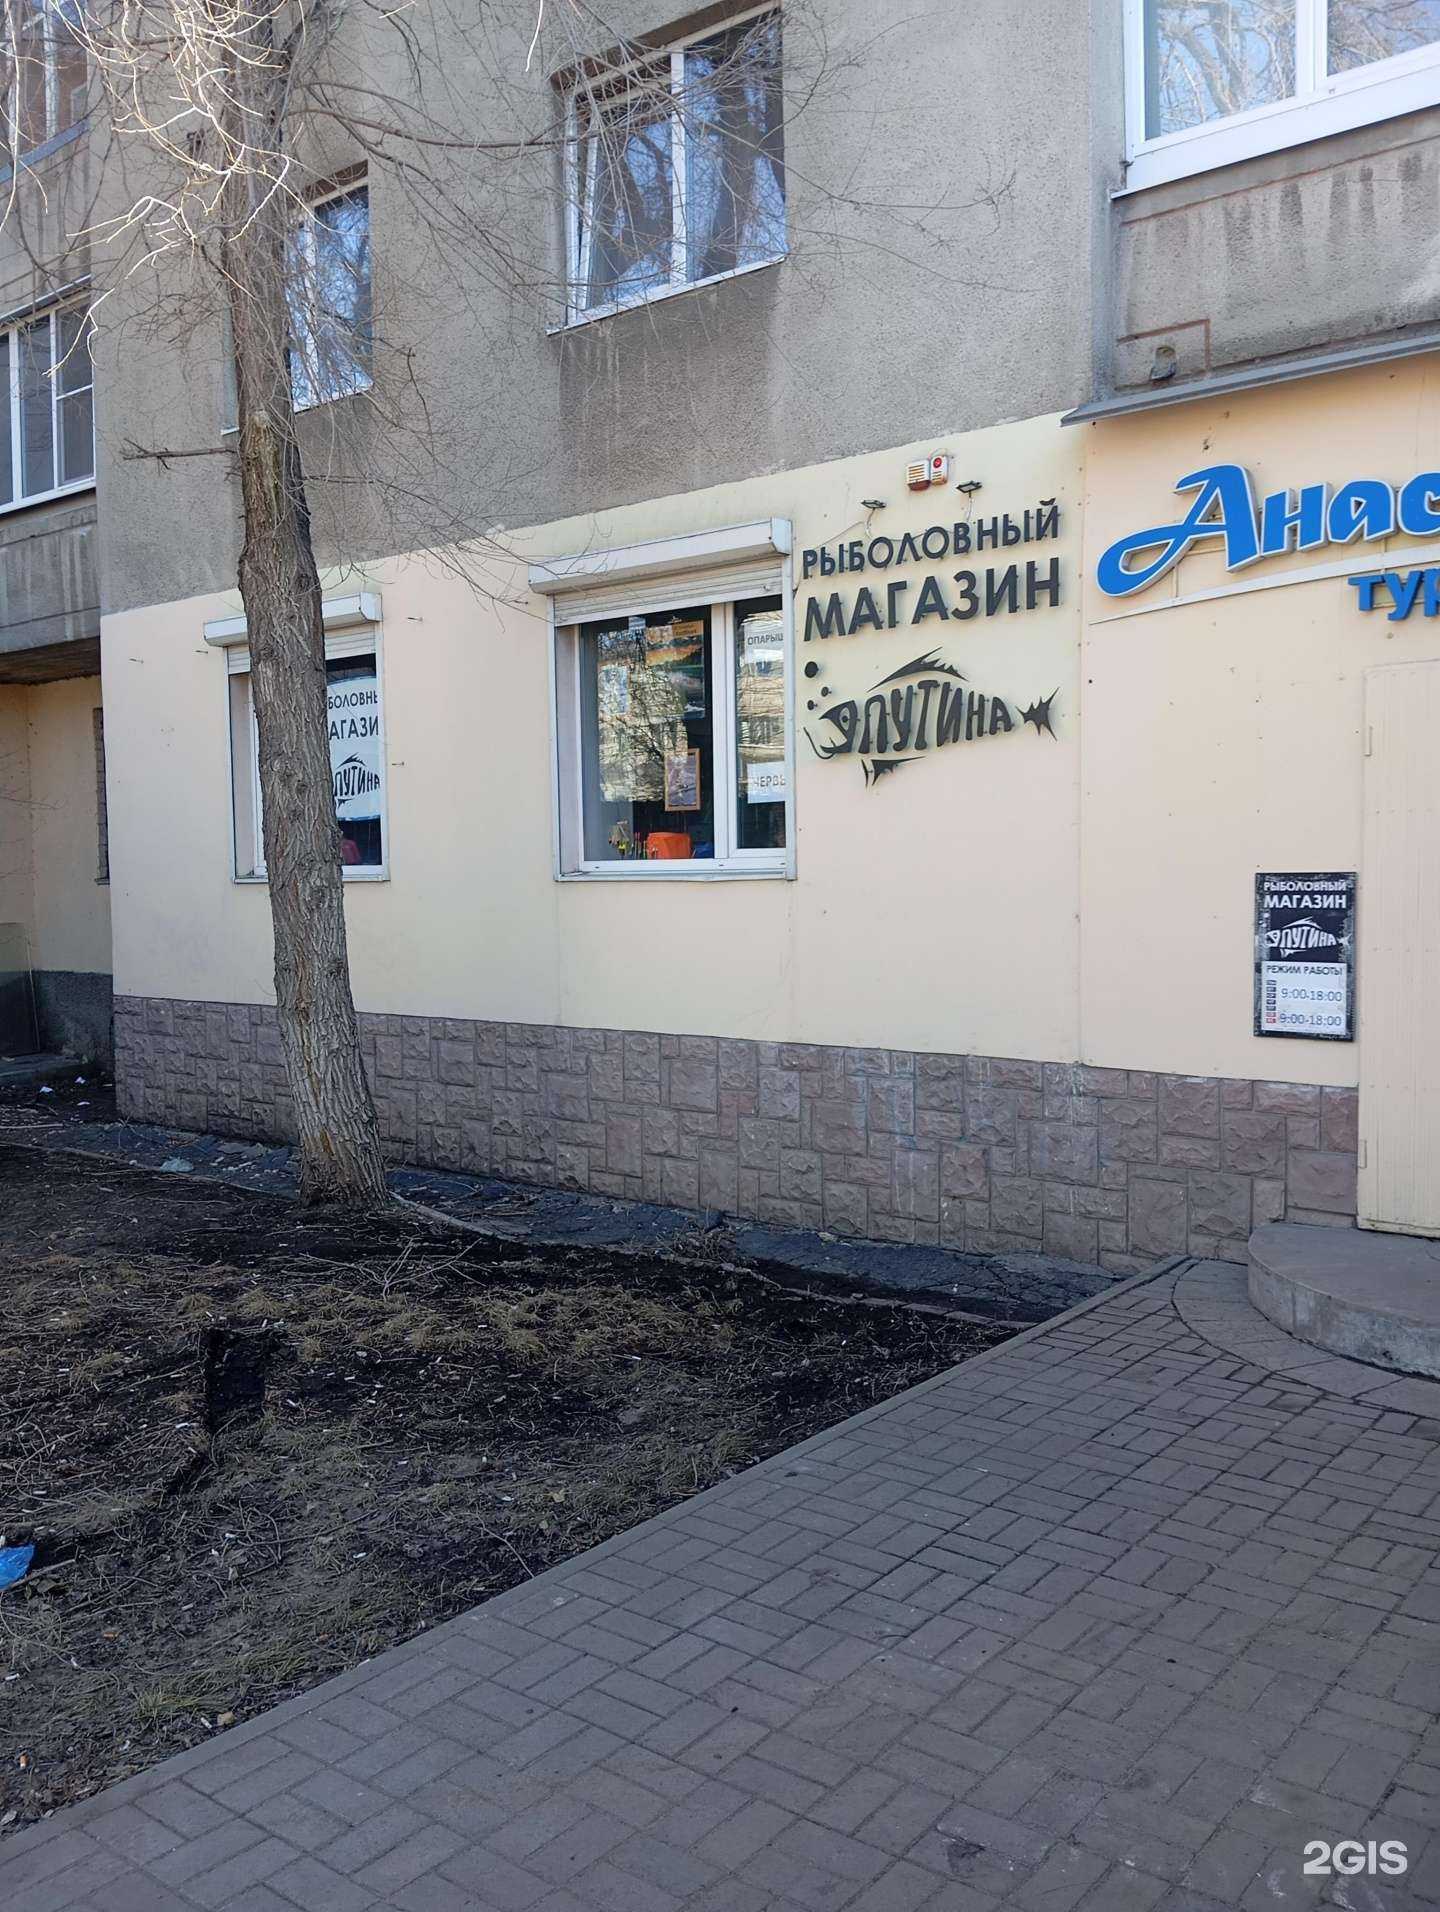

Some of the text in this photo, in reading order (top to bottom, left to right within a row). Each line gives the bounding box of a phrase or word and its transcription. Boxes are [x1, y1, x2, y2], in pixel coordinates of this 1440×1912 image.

[802, 497, 1060, 580] РЫБОЛОВНЫЙ
[1096, 463, 1440, 598] Анас
[803, 556, 1060, 642] МАГАЗИН
[858, 679, 1015, 754] ПУТИНА
[334, 765, 380, 797] ПУТИНА
[1263, 879, 1347, 892] РЫБОЛОВНЫЙ
[1263, 894, 1347, 909] МАГАЗИН
[1279, 926, 1337, 949] ПУТИНА
[1266, 964, 1343, 976] РЕЖИМ РАБОТЫ
[1280, 987, 1343, 1002] 9:00-18:00
